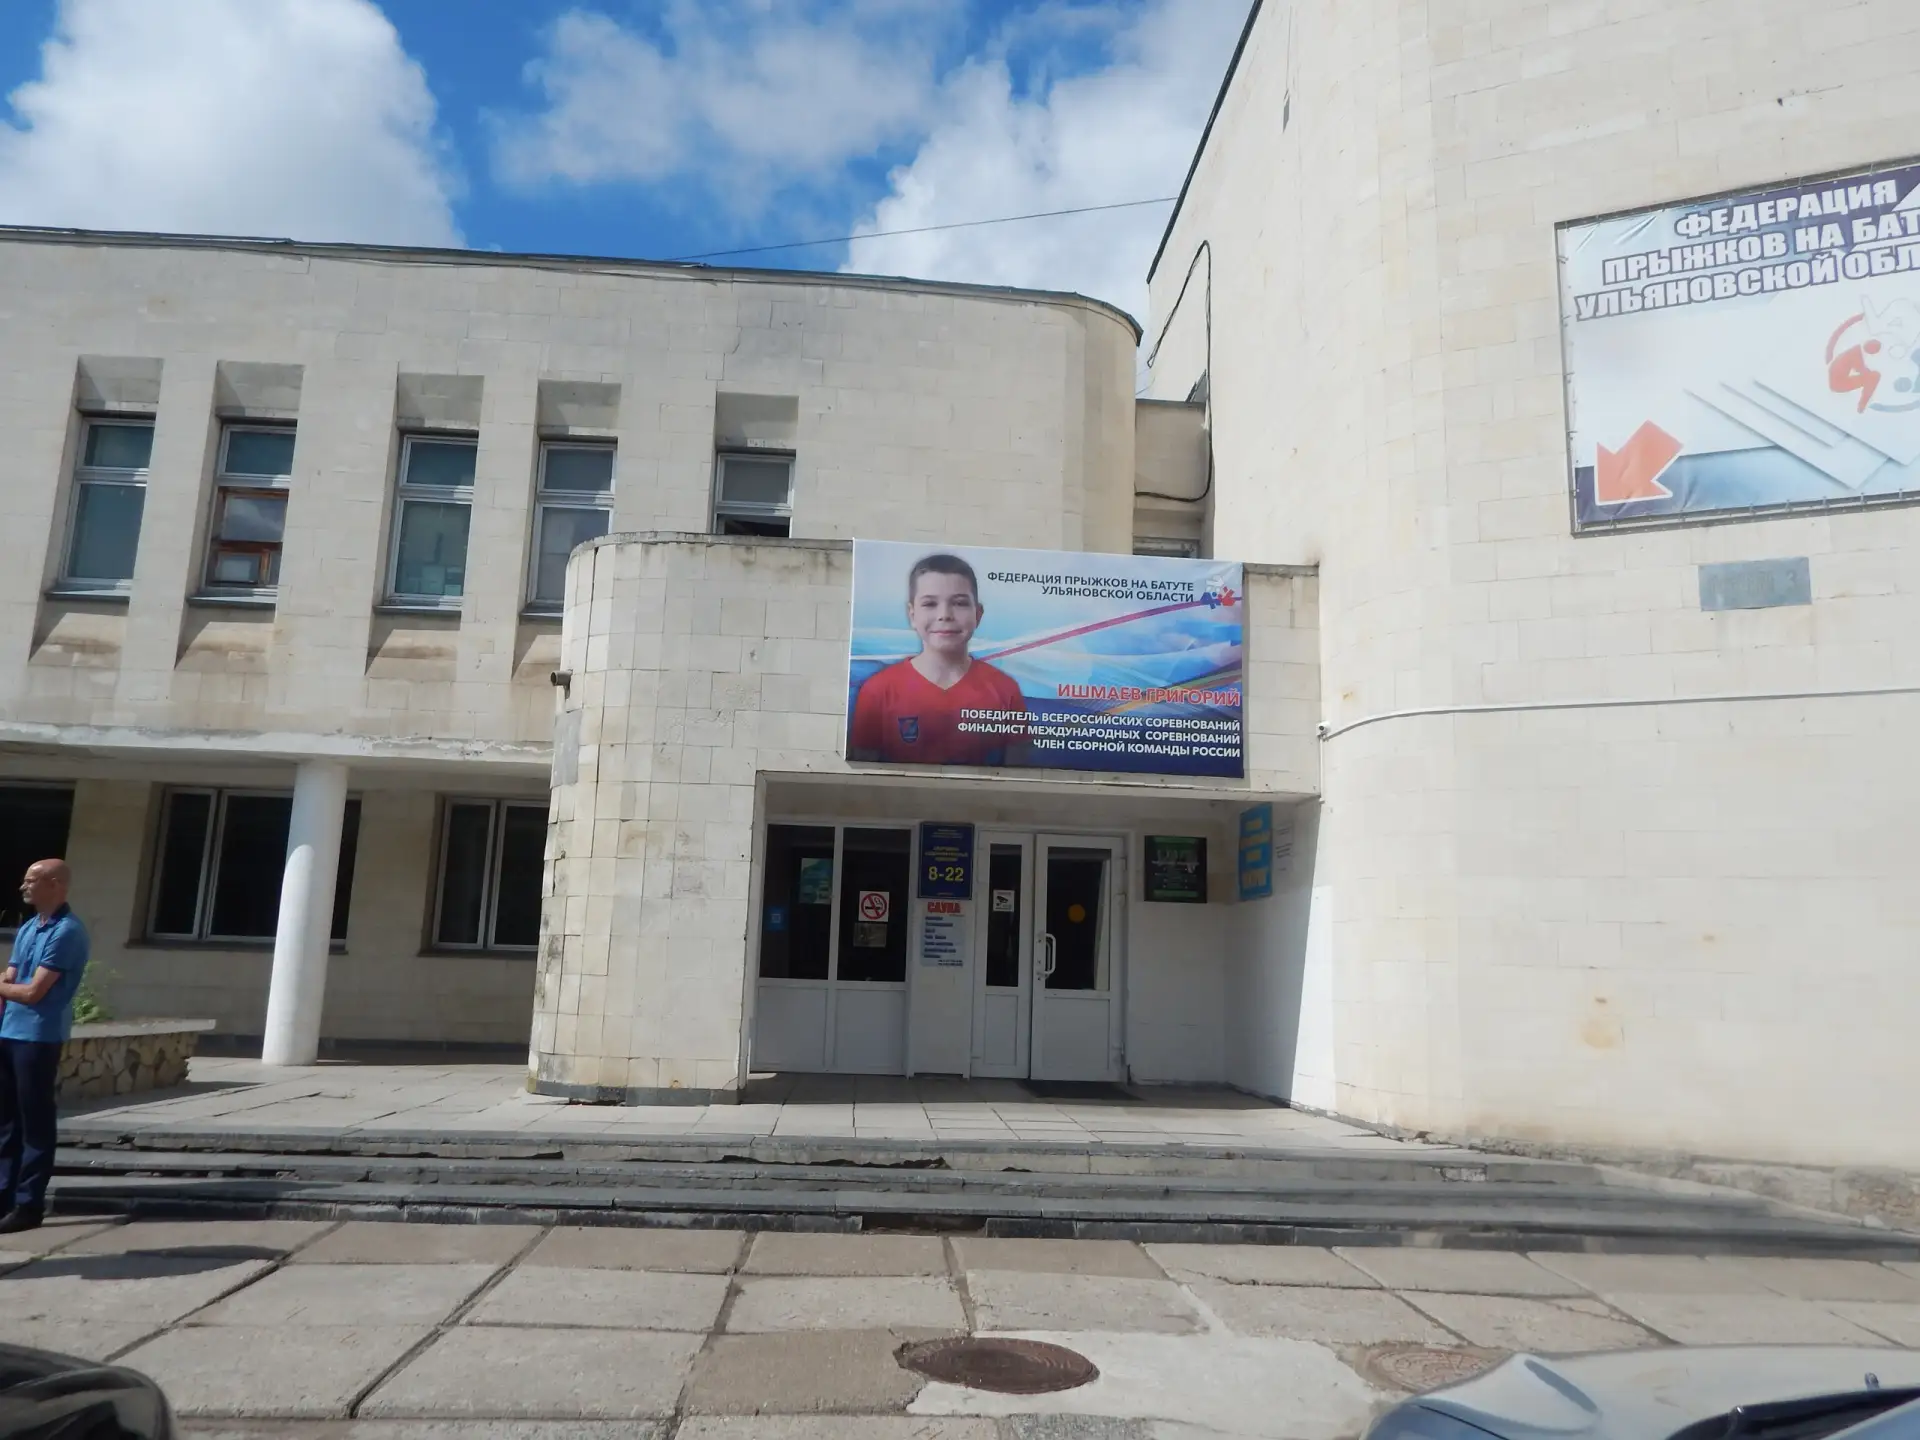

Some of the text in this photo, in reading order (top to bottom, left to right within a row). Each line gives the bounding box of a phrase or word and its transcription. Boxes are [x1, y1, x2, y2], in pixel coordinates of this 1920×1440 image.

[1675, 179, 1898, 238] ФЕДЕРАЦИЯ
[1602, 232, 1788, 285] ПРЫЖКОВ
[1795, 223, 1845, 252] НА
[1575, 254, 1838, 321] УЛЬЯНОВСКОЙ
[987, 571, 1194, 592] ФЕДЕРАЦИЯ ПРЫЖКОВ НА БАТУТЕ
[1042, 585, 1194, 603] УЛЬЯНОВСКОЙ ОБЛАСТИ
[1057, 683, 1241, 706] ИШМАЕВ ГРИГОРИЙ
[960, 708, 1241, 731] ПОБЕДИТЕЛЬ ВСЕРОССИЙСКИХ СОРЕВНОВАНИЙ
[957, 722, 1241, 745] ФИНАЛИСТ МЕЖДУНАРОДНЫХ СОРЕВНОВАНИЙ
[1033, 739, 1241, 758] ЧЛЕН СБОРНОЙ КОМАНДЫ РОССИИ
[928, 866, 964, 882] 8-22
